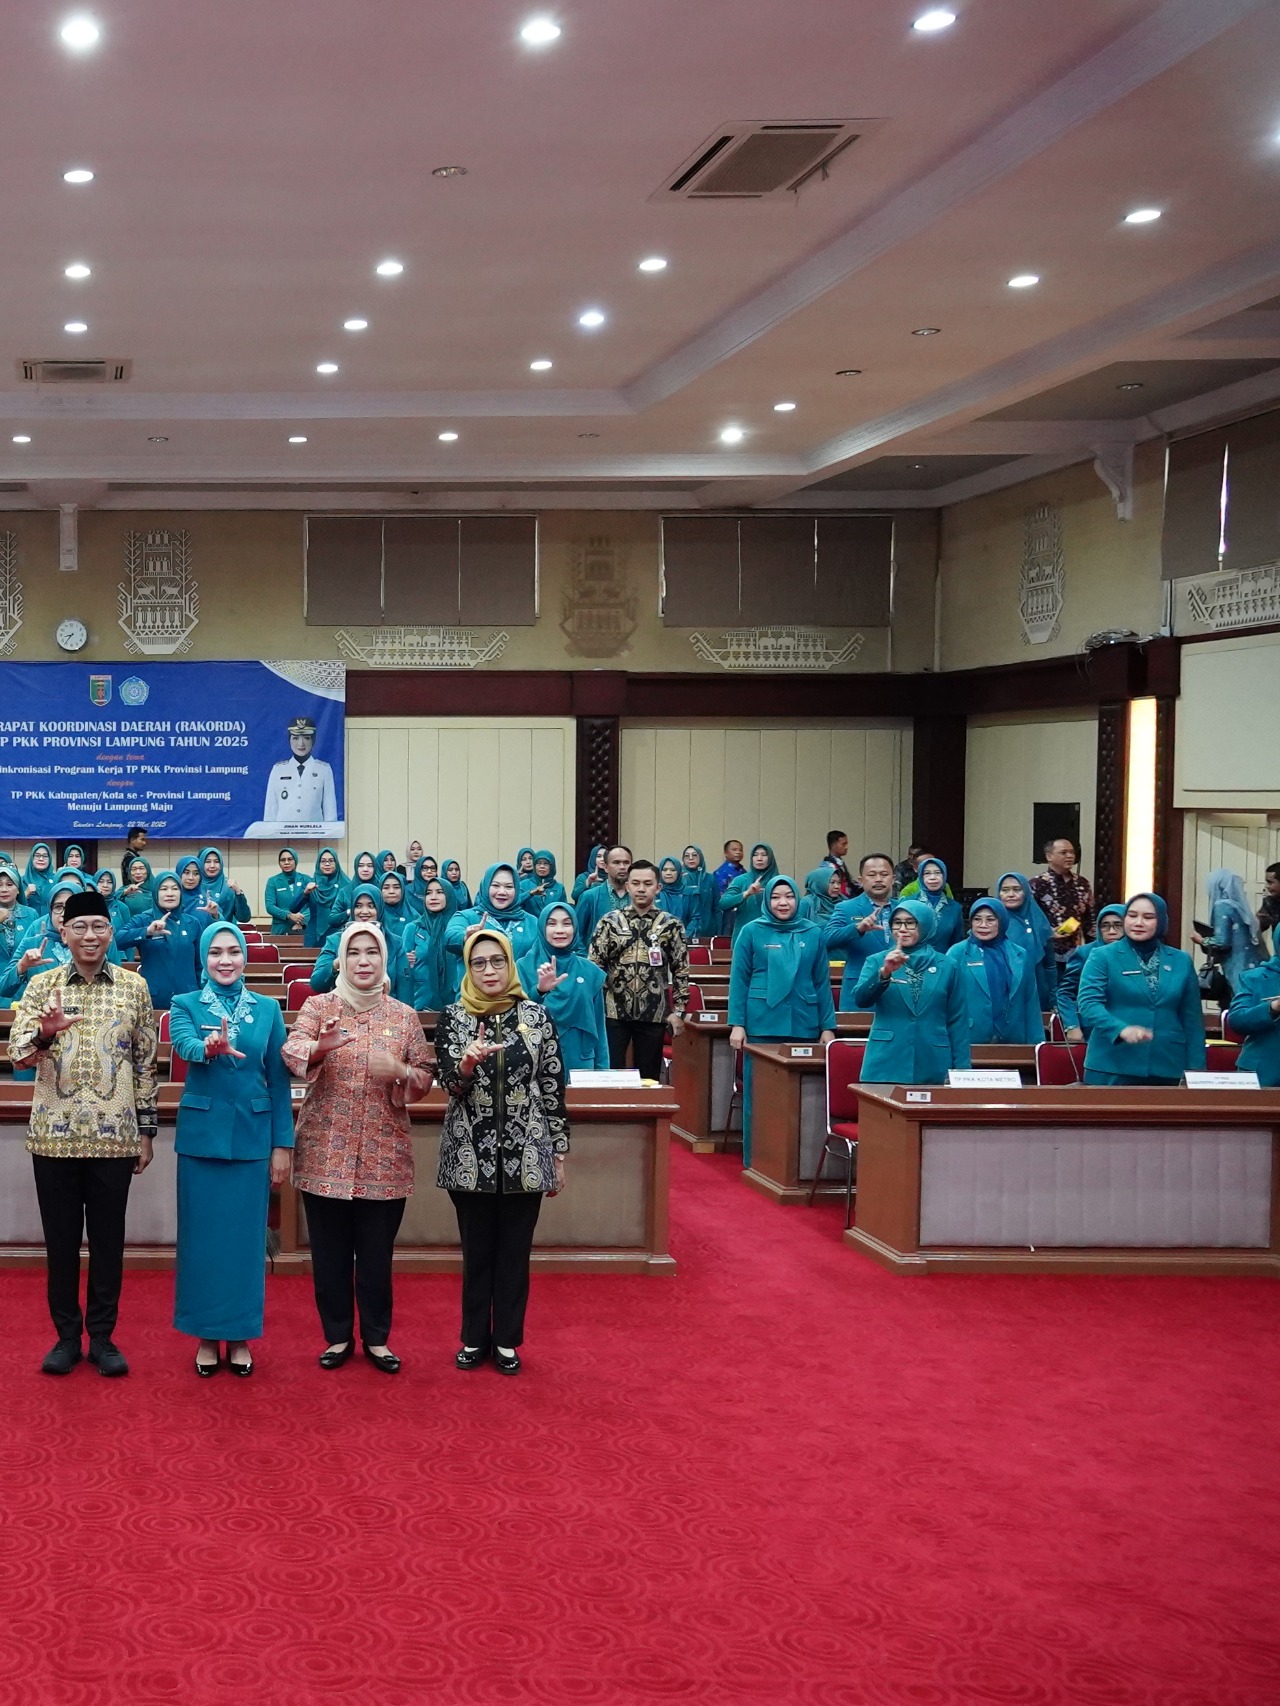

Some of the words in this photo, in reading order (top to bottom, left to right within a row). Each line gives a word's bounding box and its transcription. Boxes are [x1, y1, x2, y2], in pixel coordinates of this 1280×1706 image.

[39, 720, 117, 732] KOORDINASI
[120, 720, 171, 732] DAERAH
[174, 720, 246, 734] (RAKORDA)
[12, 736, 40, 747] PKK
[42, 736, 102, 747] PROVINSI
[105, 736, 166, 747] LAMPUNG
[168, 736, 211, 747] TAHUN
[214, 736, 249, 747] 2025
[96, 752, 123, 762] dengan
[54, 765, 95, 776] Program
[97, 765, 124, 776] Kerja
[125, 765, 139, 774] TP
[140, 765, 162, 774] PKK
[163, 764, 203, 774] Provinsi
[204, 764, 249, 776] Lampung
[10, 790, 24, 800] TP
[25, 790, 46, 800] PKK
[48, 790, 125, 802] Kabupaten/Kota
[126, 792, 138, 800] se
[145, 790, 185, 800] Provinsi
[187, 790, 232, 802] Lampung
[67, 803, 103, 813] Menuju
[104, 803, 149, 813] Lampung
[150, 803, 174, 813] Maju
[72, 820, 95, 828] Bandar
